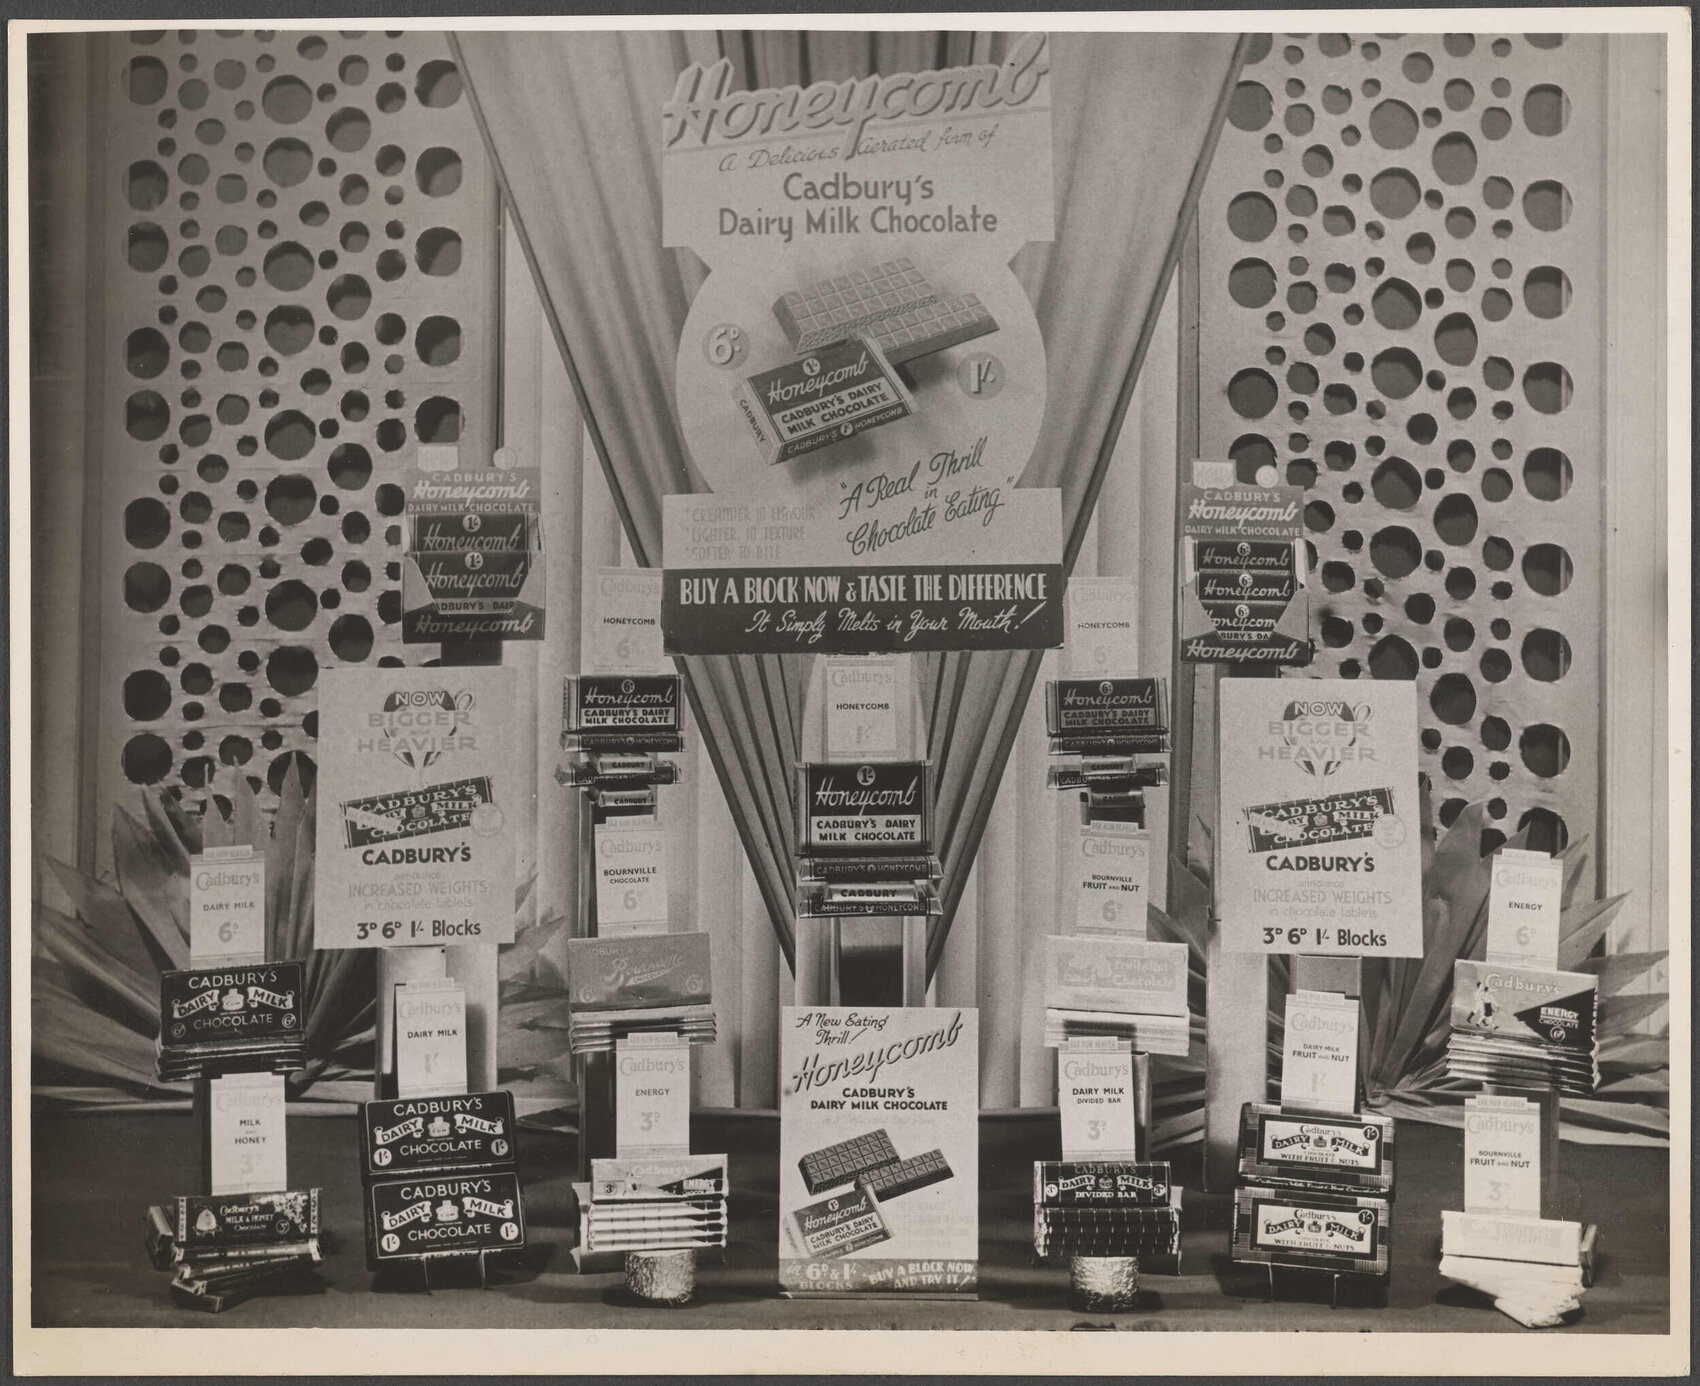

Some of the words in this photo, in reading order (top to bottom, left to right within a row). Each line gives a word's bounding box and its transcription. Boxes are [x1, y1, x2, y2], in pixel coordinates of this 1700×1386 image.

[664, 32, 1049, 160] Honeycomb
[748, 145, 840, 169] Delicious
[937, 128, 972, 150] form
[978, 123, 1000, 147] of
[783, 172, 934, 204] Cadbury's
[719, 207, 793, 242] Dairy
[806, 205, 860, 234] Milk
[871, 204, 998, 233] Chocolate
[767, 351, 870, 405] Honeycomb
[780, 395, 844, 425] CADBURY'S
[847, 381, 884, 401] DAIRY
[787, 417, 817, 436] MILK
[820, 392, 889, 423] CHOCOLATE
[866, 461, 921, 508] Real
[928, 436, 987, 486] Thrill
[412, 479, 532, 508] Honeycomb
[923, 485, 938, 500] in
[408, 503, 438, 513] DAIRY
[441, 503, 464, 512] MILK
[470, 503, 534, 512] CHOCOLATE
[1188, 499, 1299, 528] Honeycomb
[846, 503, 937, 556] Chocolate
[1185, 525, 1212, 534] DAIRY
[1241, 527, 1300, 536] CHOCOLATE
[1203, 548, 1290, 569] Honeycomb
[425, 561, 525, 597] Honeycomb
[680, 577, 718, 605] BUY
[723, 577, 740, 604] A
[744, 576, 799, 604] BLOCK
[803, 576, 842, 603] NOW
[845, 582, 857, 602] &
[857, 575, 907, 602] TASTE
[913, 574, 943, 602] THE
[948, 573, 1048, 601] DIFFERENCE
[1204, 579, 1291, 601] Honeycomb
[415, 613, 535, 640] Honeycomb
[745, 609, 771, 633] It
[776, 609, 827, 644] Simply
[838, 608, 880, 633] Melts
[885, 612, 902, 634] in
[910, 609, 948, 642] Your
[1187, 640, 1299, 662] Honeycomb
[395, 691, 446, 706] NOW
[585, 685, 673, 708] Honeycomb
[1064, 686, 1153, 707] Honeycomb
[1294, 702, 1344, 715] NOW
[368, 711, 473, 728] BIGGER
[612, 716, 668, 724] CHOCOLATE
[1268, 721, 1371, 737] BIGGER
[357, 736, 478, 752] HEAVIER
[1258, 746, 1378, 761] HEAVIER
[816, 775, 919, 816] Honeycomb
[817, 818, 877, 829] CADBURY'S
[885, 819, 915, 828] DAIRY
[819, 832, 846, 841] MILK
[855, 831, 915, 841] CHOCOLATE
[362, 842, 471, 865] CADBURY'S
[1266, 852, 1375, 872] CADBURY'S
[604, 867, 657, 876] BOURNVILLE
[1092, 874, 1132, 882] BOURNVILLE
[429, 880, 487, 895] WEIGHTS
[841, 889, 896, 897] CADBURY
[1121, 884, 1139, 892] NUT
[1253, 889, 1327, 903] INCREASED
[1332, 891, 1392, 905] WEIGHTS
[203, 903, 229, 911] DAIRY
[233, 901, 255, 909] MILK
[1509, 902, 1542, 911] ENERGY
[432, 919, 481, 937] Blocks
[1338, 929, 1386, 946] Blocks
[189, 969, 277, 989] CADBURY'S
[178, 990, 215, 1016] DAIRY
[253, 989, 288, 1008] MILK
[194, 1014, 272, 1029] CHOCOLATE
[796, 1013, 813, 1028] A
[815, 1012, 842, 1027] New
[845, 1013, 889, 1031] Eating
[1541, 1007, 1579, 1020] ENERGY
[407, 1030, 432, 1038] DAIRY
[437, 1029, 457, 1037] MILK
[792, 1010, 963, 1093] Honeycomb
[1293, 1051, 1316, 1059] FRUIT
[1331, 1054, 1349, 1062] NUT
[635, 1088, 670, 1096] ENERGY
[842, 1086, 915, 1098] CADBURY'S
[393, 1098, 482, 1116] CADBURY'S
[811, 1100, 846, 1110] DAIRY
[852, 1101, 879, 1110] MILK
[884, 1100, 948, 1110] CHOCOLATE
[381, 1120, 418, 1142] DAIRY
[461, 1117, 498, 1132] MILK
[234, 1136, 266, 1145] HONEY
[400, 1140, 482, 1155] CHOCOLATE
[1275, 1136, 1309, 1149] DAIRY
[1332, 1138, 1363, 1153] MILK
[401, 1180, 491, 1199] CADBURY'S
[1062, 1177, 1092, 1189] DAIRY
[1120, 1177, 1151, 1188] MILK
[389, 1203, 427, 1227] DAIRY
[469, 1201, 506, 1216] MILK
[804, 1197, 868, 1230] Honeycomb
[853, 1216, 874, 1229] DAIRY
[1269, 1222, 1301, 1234] DAIRY
[1327, 1225, 1359, 1239] MILK
[408, 1224, 491, 1241] CHOCOLATE
[813, 1239, 833, 1249] MILK
[835, 1223, 878, 1241] CHOCOLATE
[907, 1263, 944, 1274] BLOCK
[947, 1262, 975, 1273] NOW
[800, 1280, 852, 1289] BLOCKS
[921, 1275, 943, 1285] TRY
